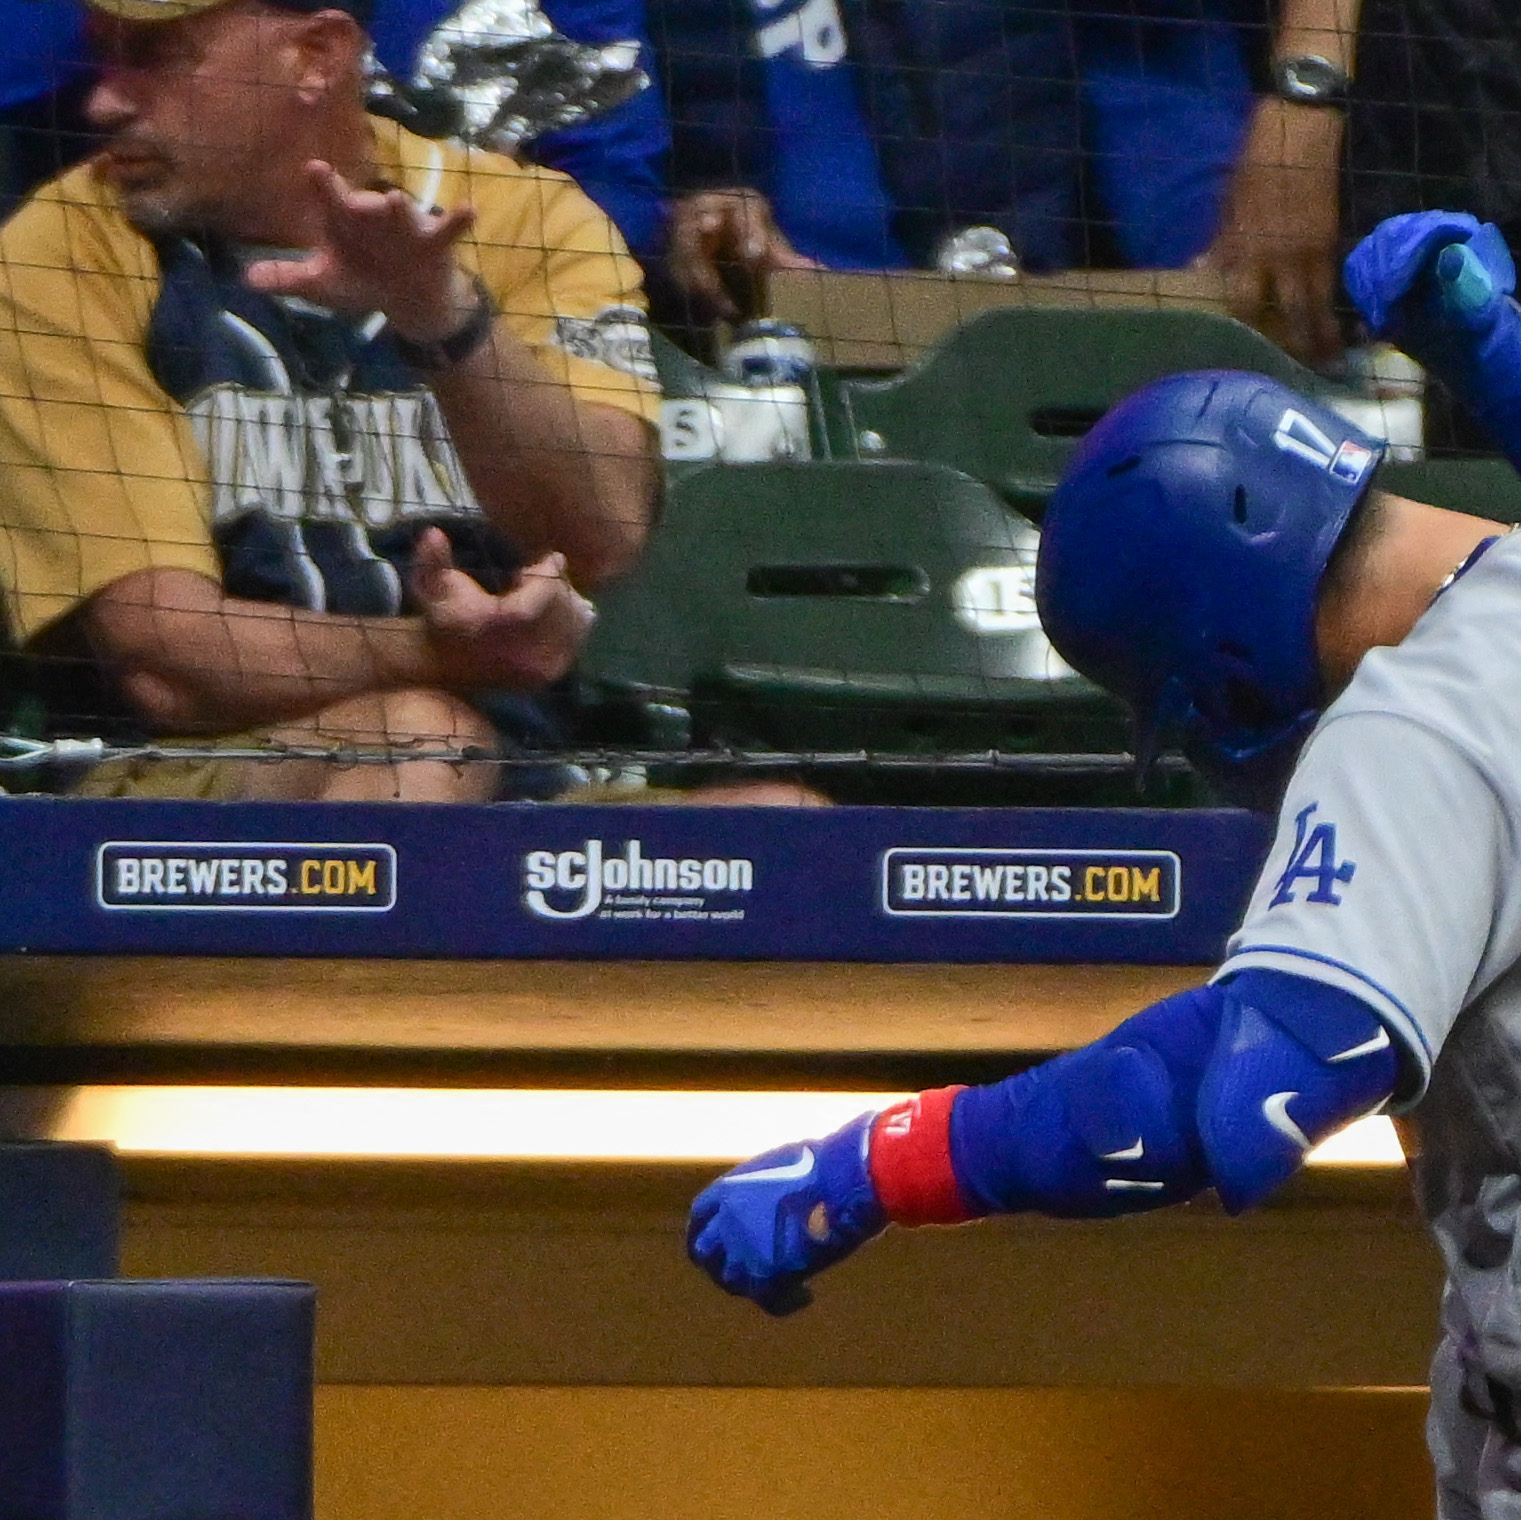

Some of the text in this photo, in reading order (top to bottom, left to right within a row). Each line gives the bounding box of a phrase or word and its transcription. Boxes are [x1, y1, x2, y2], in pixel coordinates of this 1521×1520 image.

[1273, 408, 1338, 470] 17
[116, 858, 377, 896] BREWERS.COM
[1269, 803, 1357, 910] LA
[902, 866, 1161, 901] BREWERS.COM
